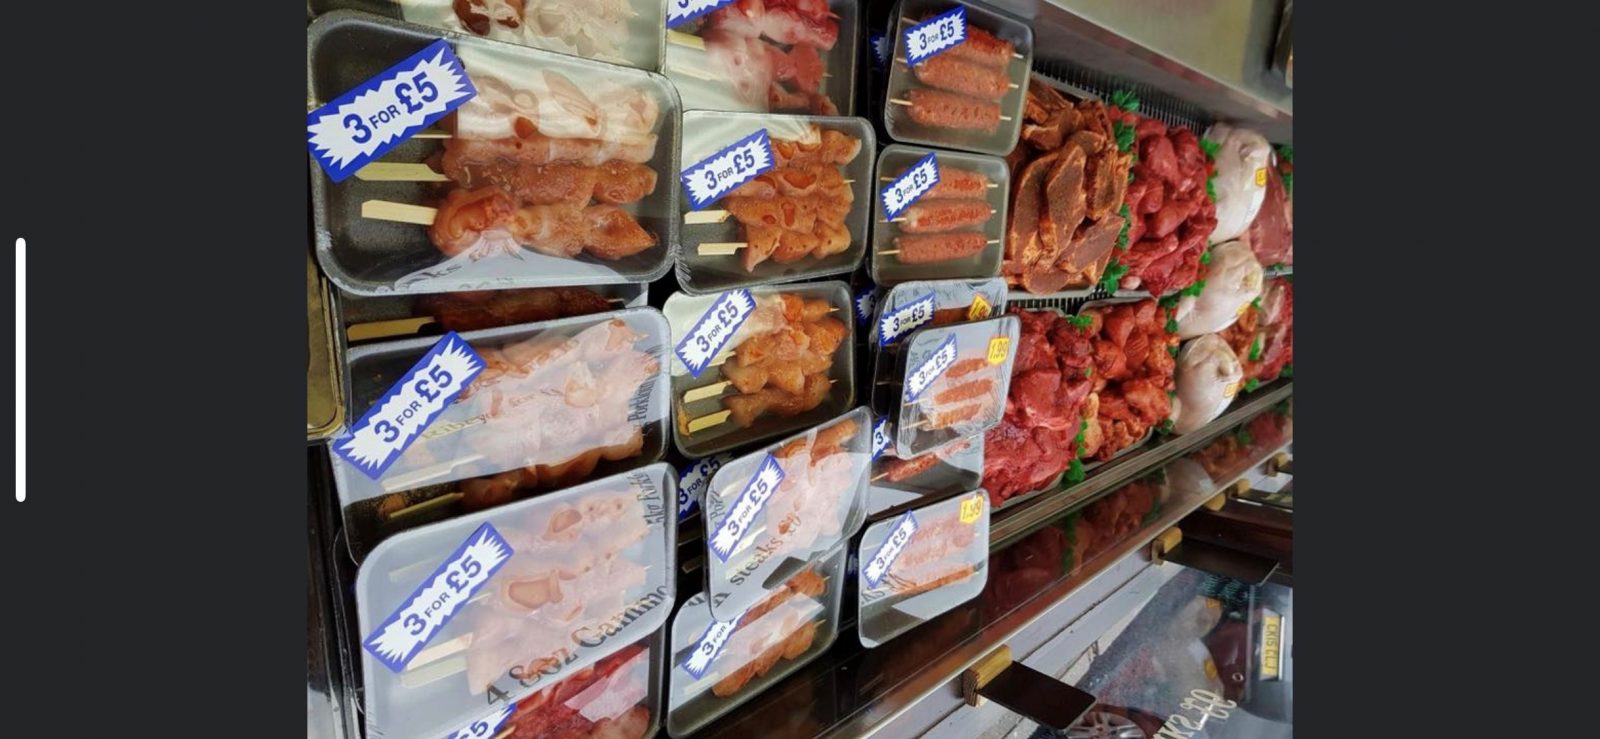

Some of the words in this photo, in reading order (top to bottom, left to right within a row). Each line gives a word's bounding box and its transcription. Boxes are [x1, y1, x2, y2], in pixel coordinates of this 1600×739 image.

[919, 33, 928, 50] 3
[939, 20, 955, 42] £5
[343, 112, 370, 145] 3
[368, 104, 401, 130] FOR
[395, 71, 439, 115] £5
[704, 170, 718, 190] 3
[717, 167, 734, 181] FOR
[733, 149, 755, 175] £5
[894, 188, 904, 203] 3
[913, 168, 928, 189] £5
[696, 335, 710, 352] 3
[707, 324, 722, 342] FOR
[717, 300, 738, 328] £5
[893, 317, 900, 332] 3
[912, 305, 925, 322] £5
[919, 371, 926, 385] 3
[935, 349, 948, 368] £5
[373, 420, 400, 444] 3
[395, 400, 422, 428] FOR
[414, 364, 453, 403] £5
[876, 432, 884, 445] 3
[679, 487, 689, 505] 3
[686, 478, 703, 495] FOR
[728, 520, 740, 537] 3
[749, 478, 768, 506] £5
[876, 557, 885, 570] 3
[893, 526, 907, 548] £5
[403, 613, 426, 637] 3
[424, 592, 450, 617] FOR
[446, 554, 482, 593] £5
[702, 641, 714, 656] 3
[486, 683, 510, 705] 4
